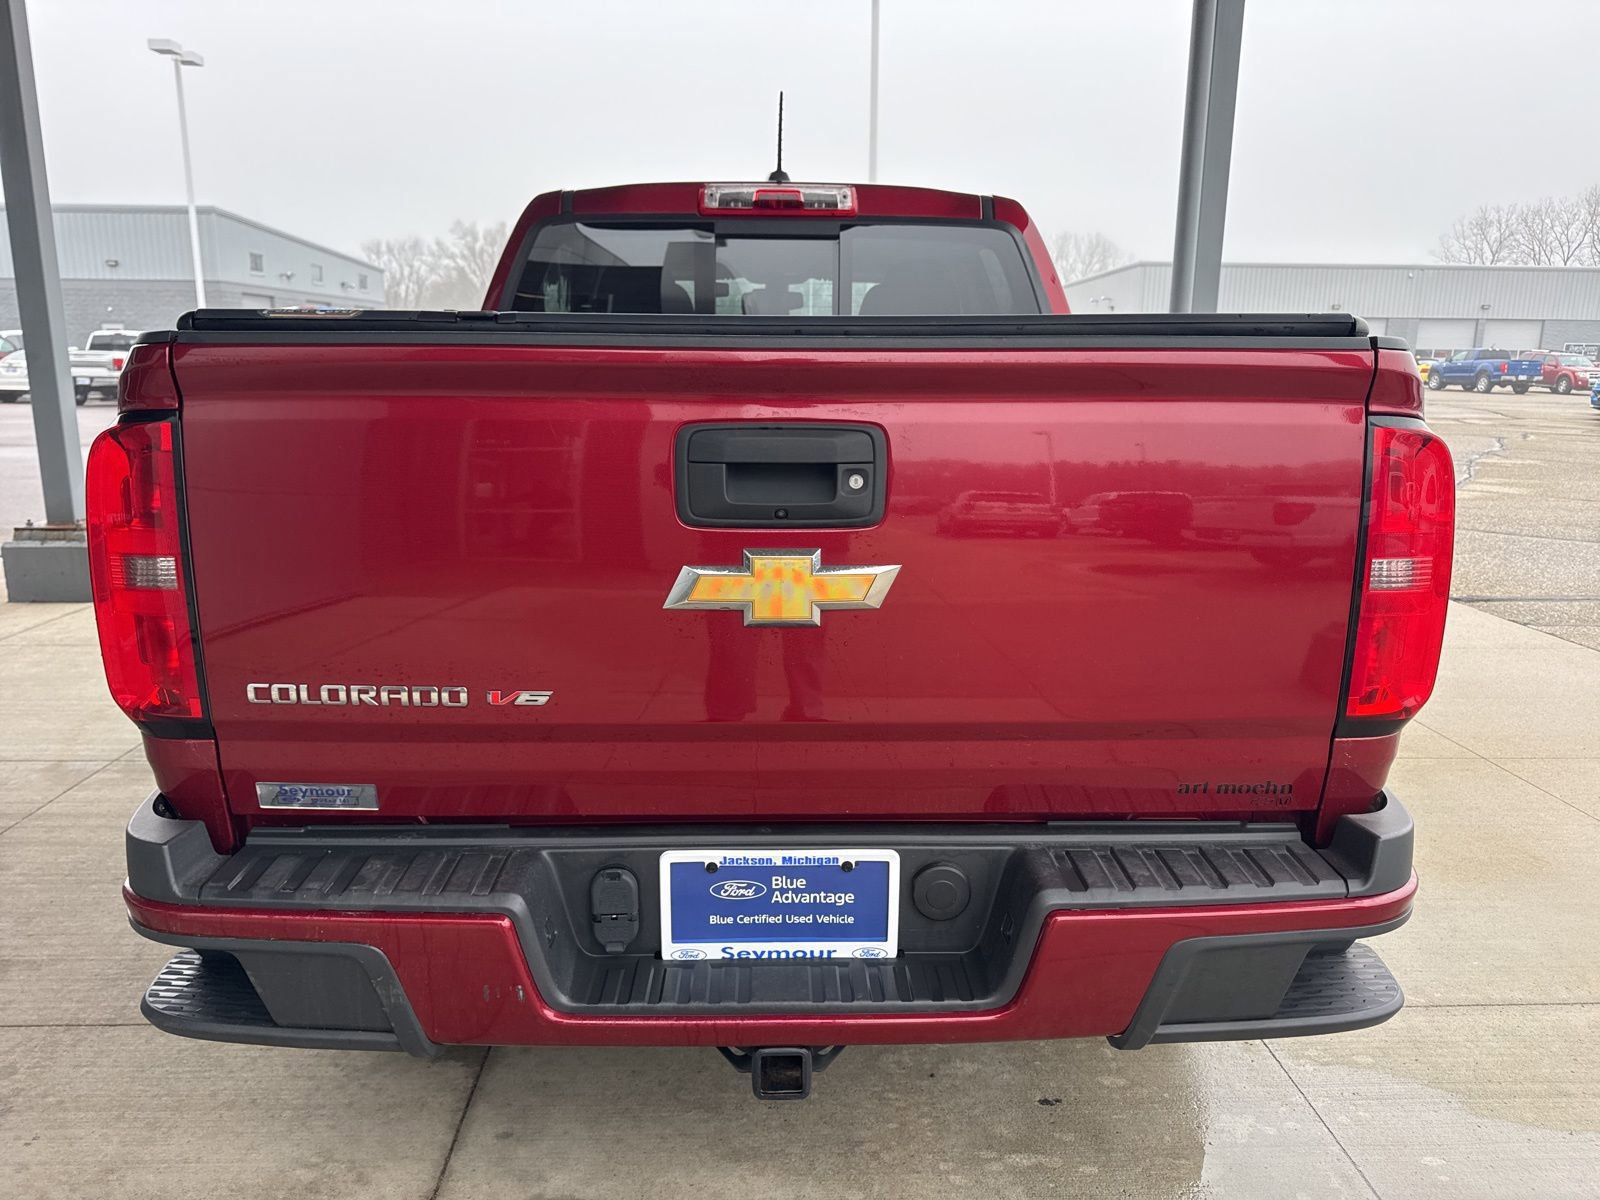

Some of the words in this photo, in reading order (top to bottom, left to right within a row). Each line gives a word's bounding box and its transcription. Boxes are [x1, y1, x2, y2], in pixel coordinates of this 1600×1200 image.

[246, 683, 468, 706] COLORADO
[487, 690, 554, 706] V6
[279, 784, 353, 798] Seymour
[719, 856, 777, 866] Jackson,
[781, 856, 839, 866] Michigan
[720, 882, 756, 896] Ford
[771, 875, 807, 889] Blue
[771, 891, 855, 906] Advantage
[709, 915, 734, 925] Blue
[736, 914, 783, 924] Certified
[786, 914, 813, 924] Used
[816, 914, 855, 924] Vehicle
